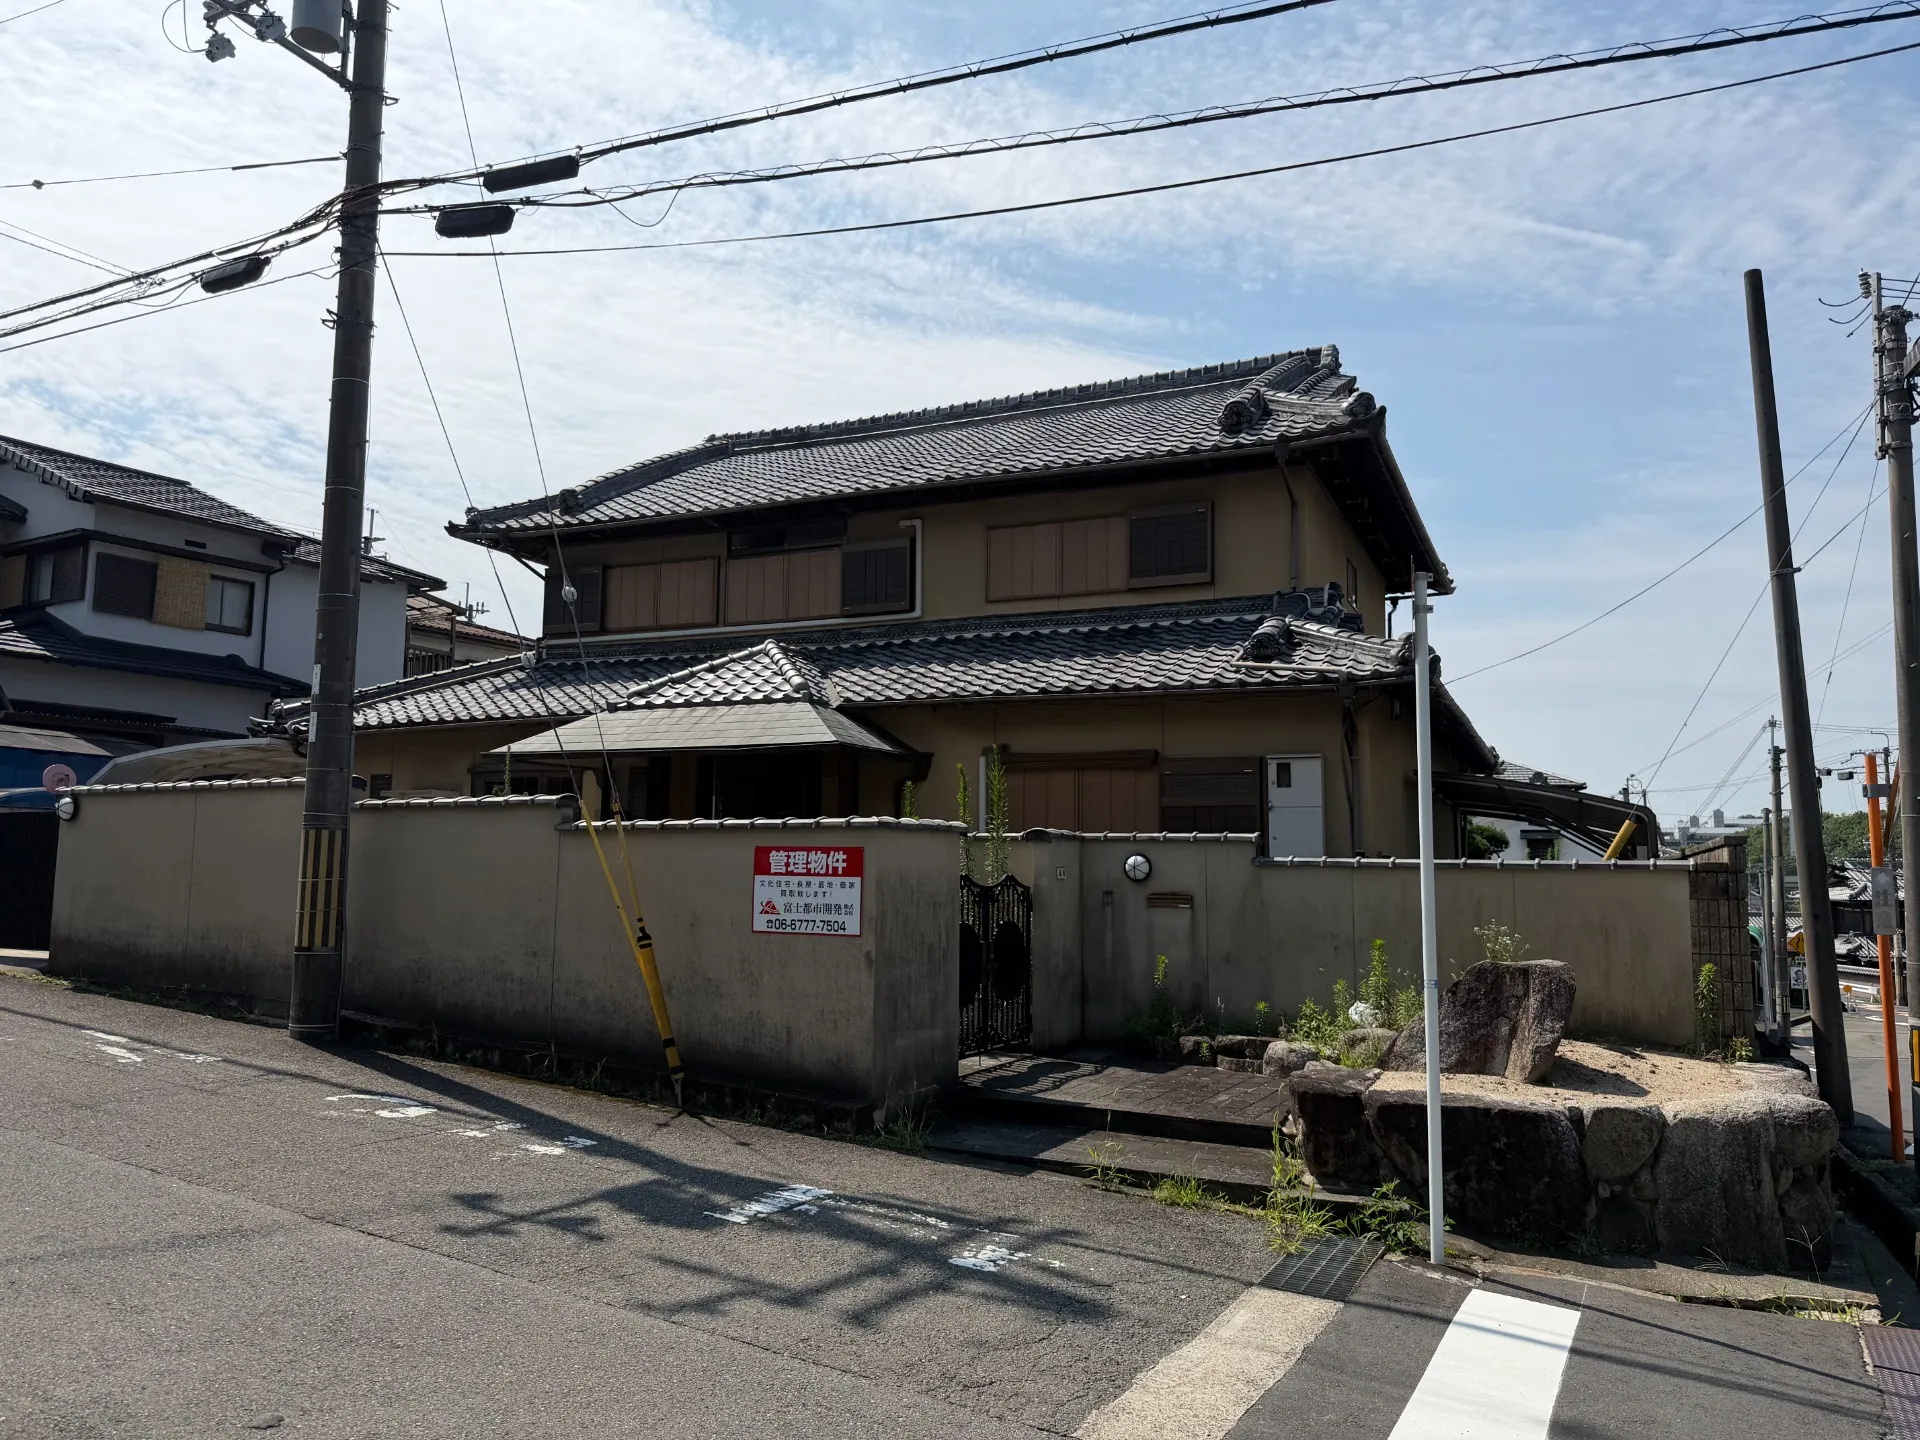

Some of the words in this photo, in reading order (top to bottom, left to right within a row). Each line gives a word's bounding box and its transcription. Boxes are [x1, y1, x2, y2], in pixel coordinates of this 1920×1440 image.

[769, 850, 847, 874] 管理物件
[774, 918, 847, 932] 06-6777-7504
